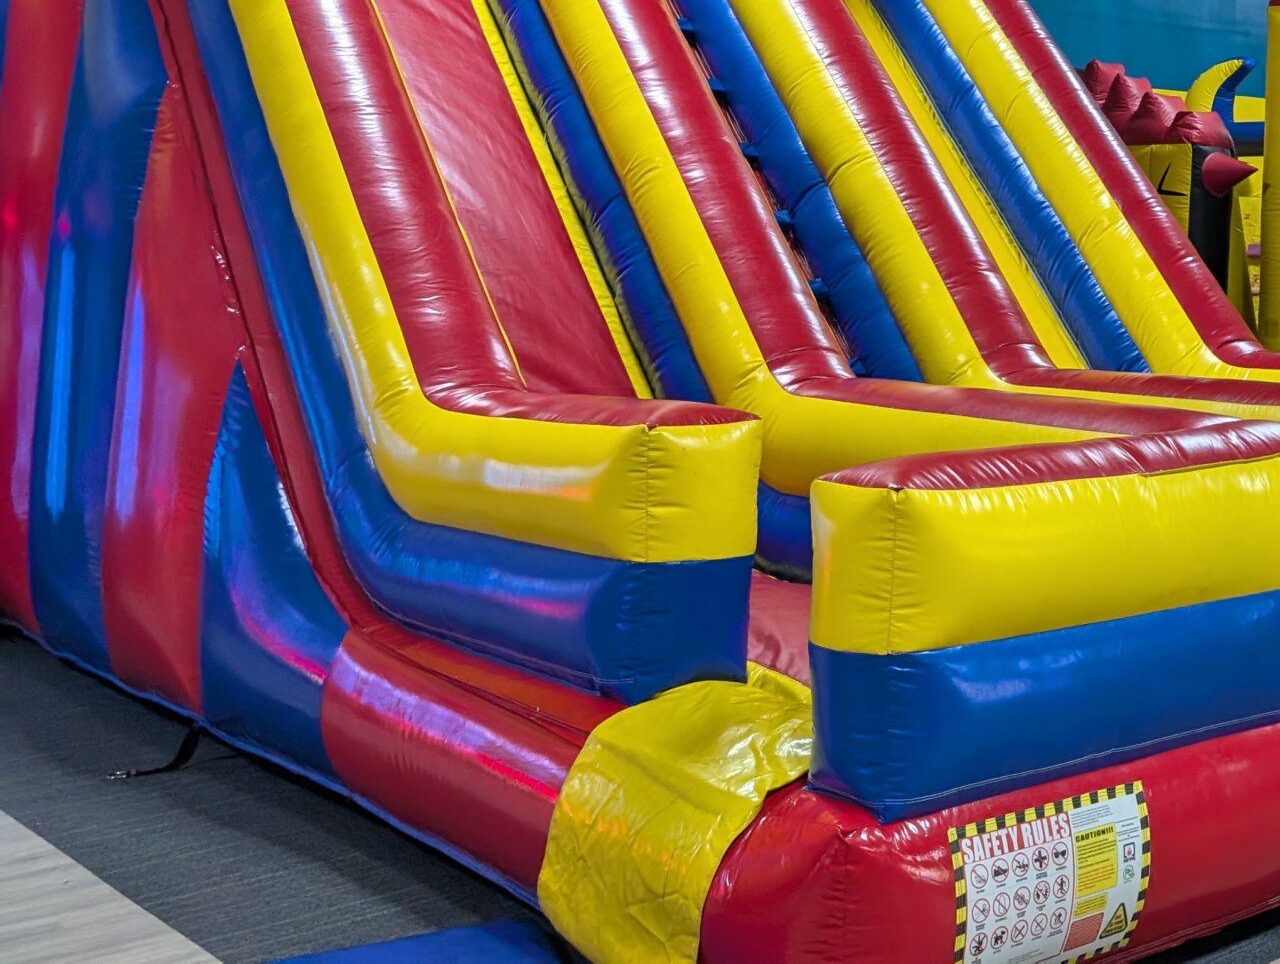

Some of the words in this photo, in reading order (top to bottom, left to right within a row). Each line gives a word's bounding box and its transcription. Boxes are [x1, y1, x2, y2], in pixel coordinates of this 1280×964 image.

[961, 827, 1021, 864] SAFETY
[1023, 813, 1070, 848] RULES
[1075, 826, 1114, 843] CAUTION!!!
